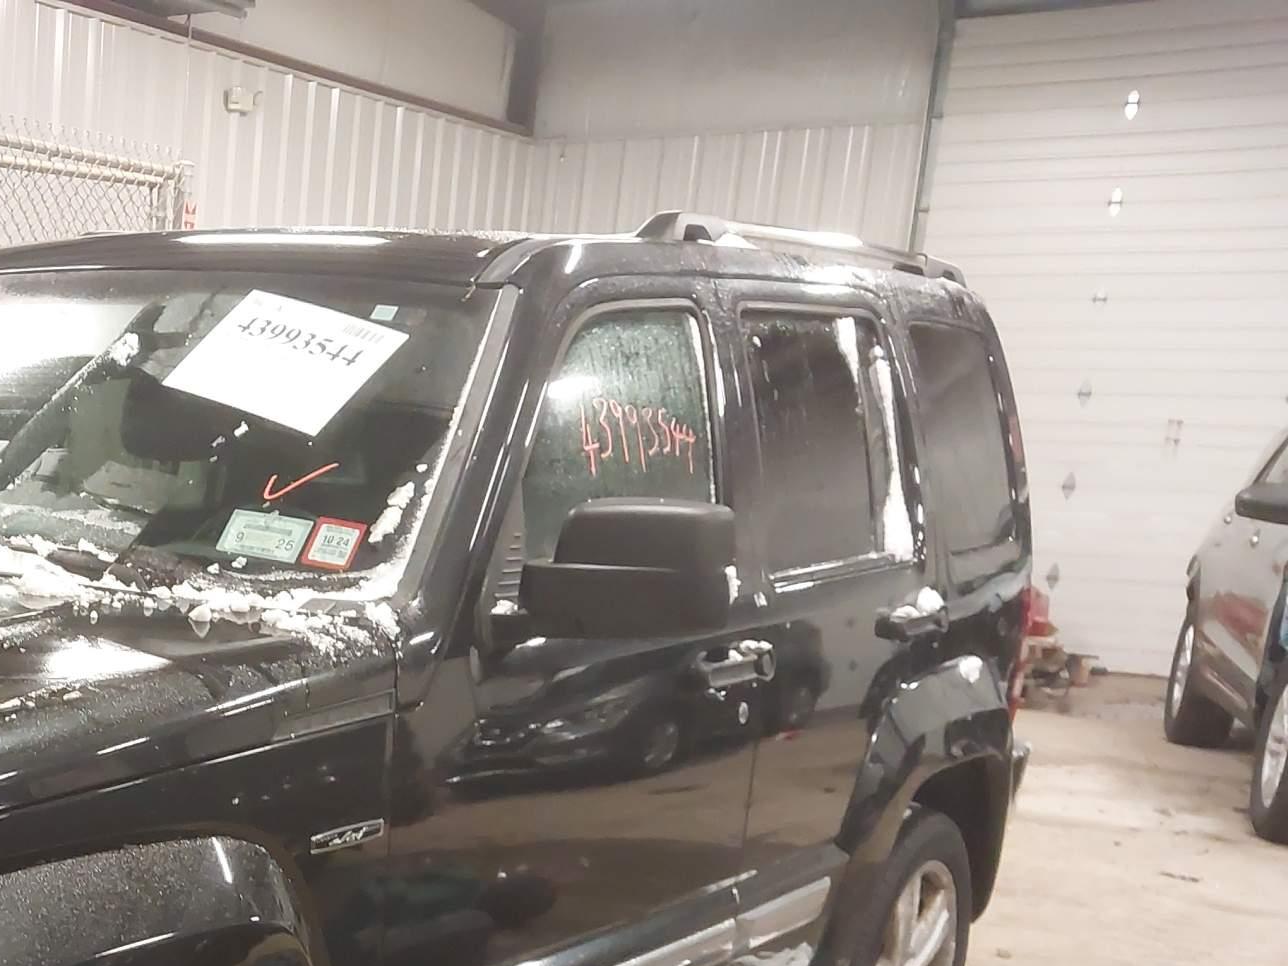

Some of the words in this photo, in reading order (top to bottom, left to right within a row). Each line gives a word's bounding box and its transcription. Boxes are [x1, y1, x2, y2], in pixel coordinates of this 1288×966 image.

[238, 317, 363, 366] 43993544
[579, 398, 696, 476] 43993544
[234, 531, 245, 543] 9
[274, 538, 294, 552] 25
